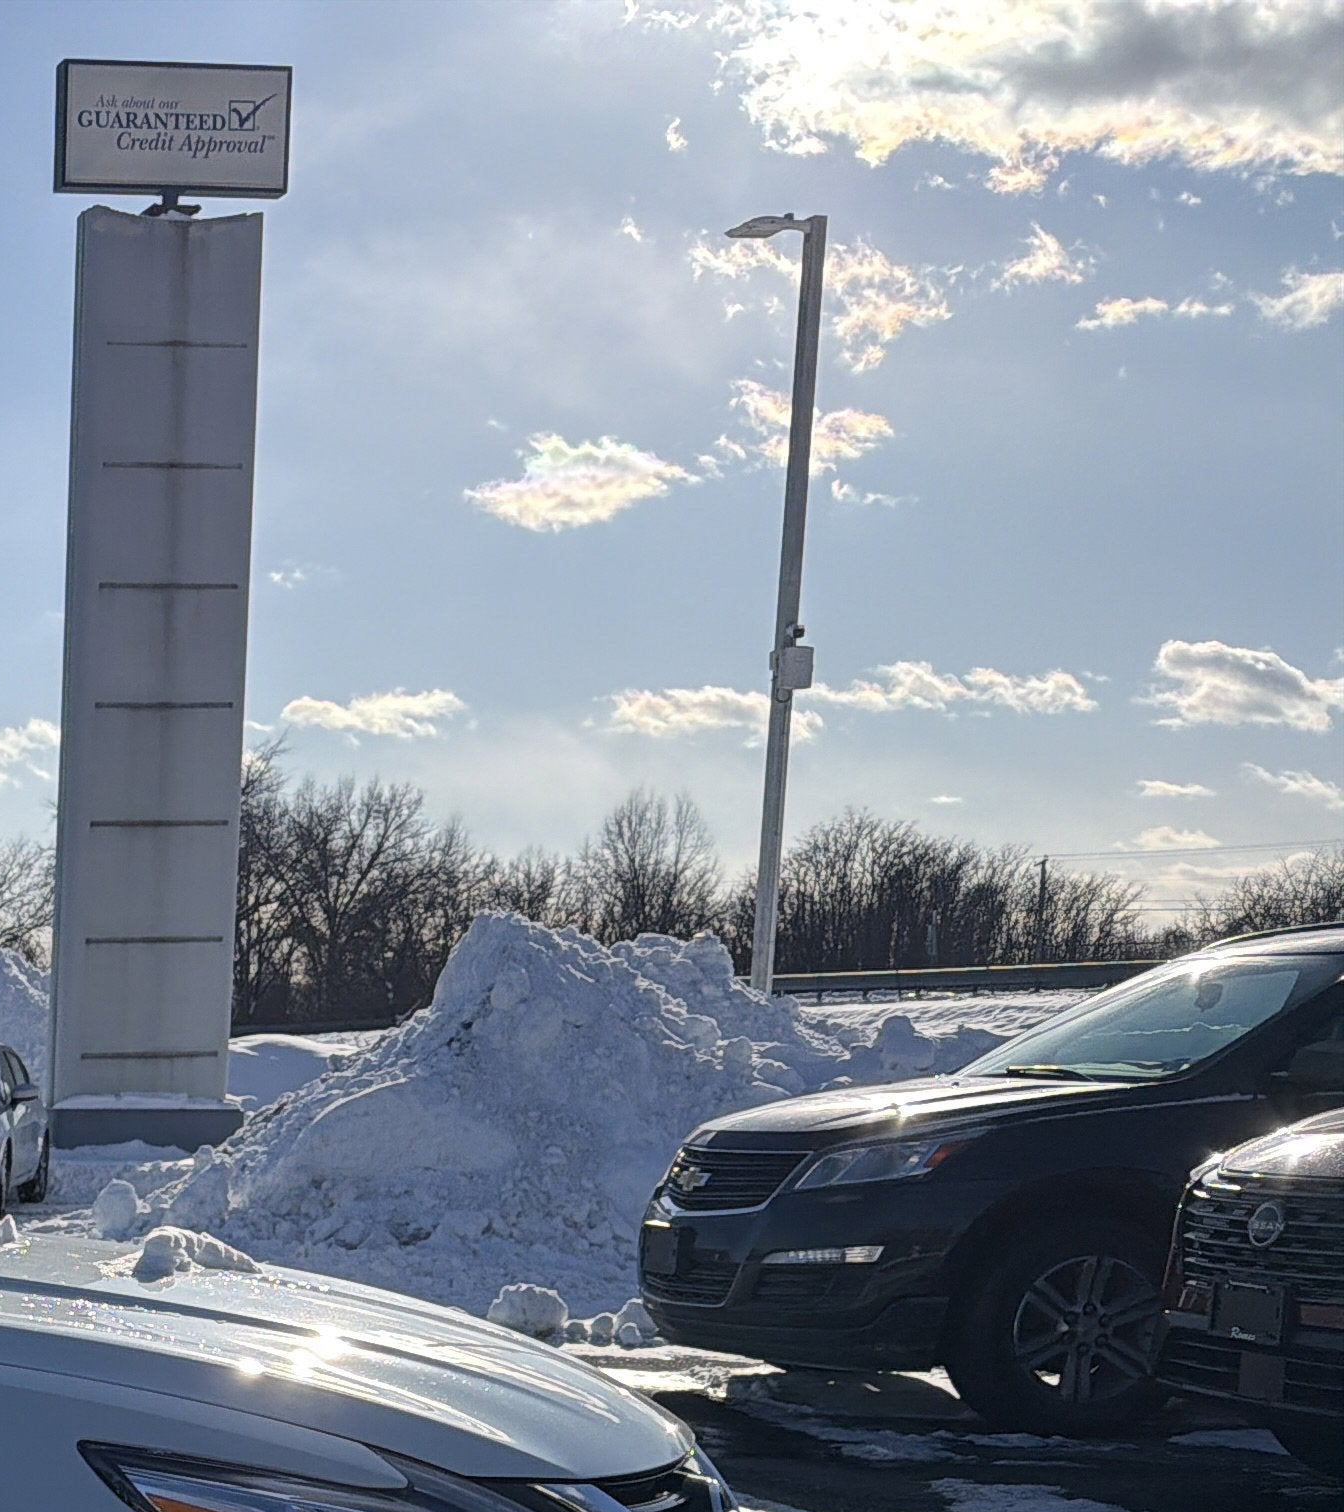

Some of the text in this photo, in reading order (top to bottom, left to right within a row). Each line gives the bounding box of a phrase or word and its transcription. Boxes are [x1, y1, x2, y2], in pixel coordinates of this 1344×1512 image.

[95, 94, 179, 110] Ask about our
[77, 110, 226, 131] GUARANTEED
[116, 131, 267, 159] Credit Approval
